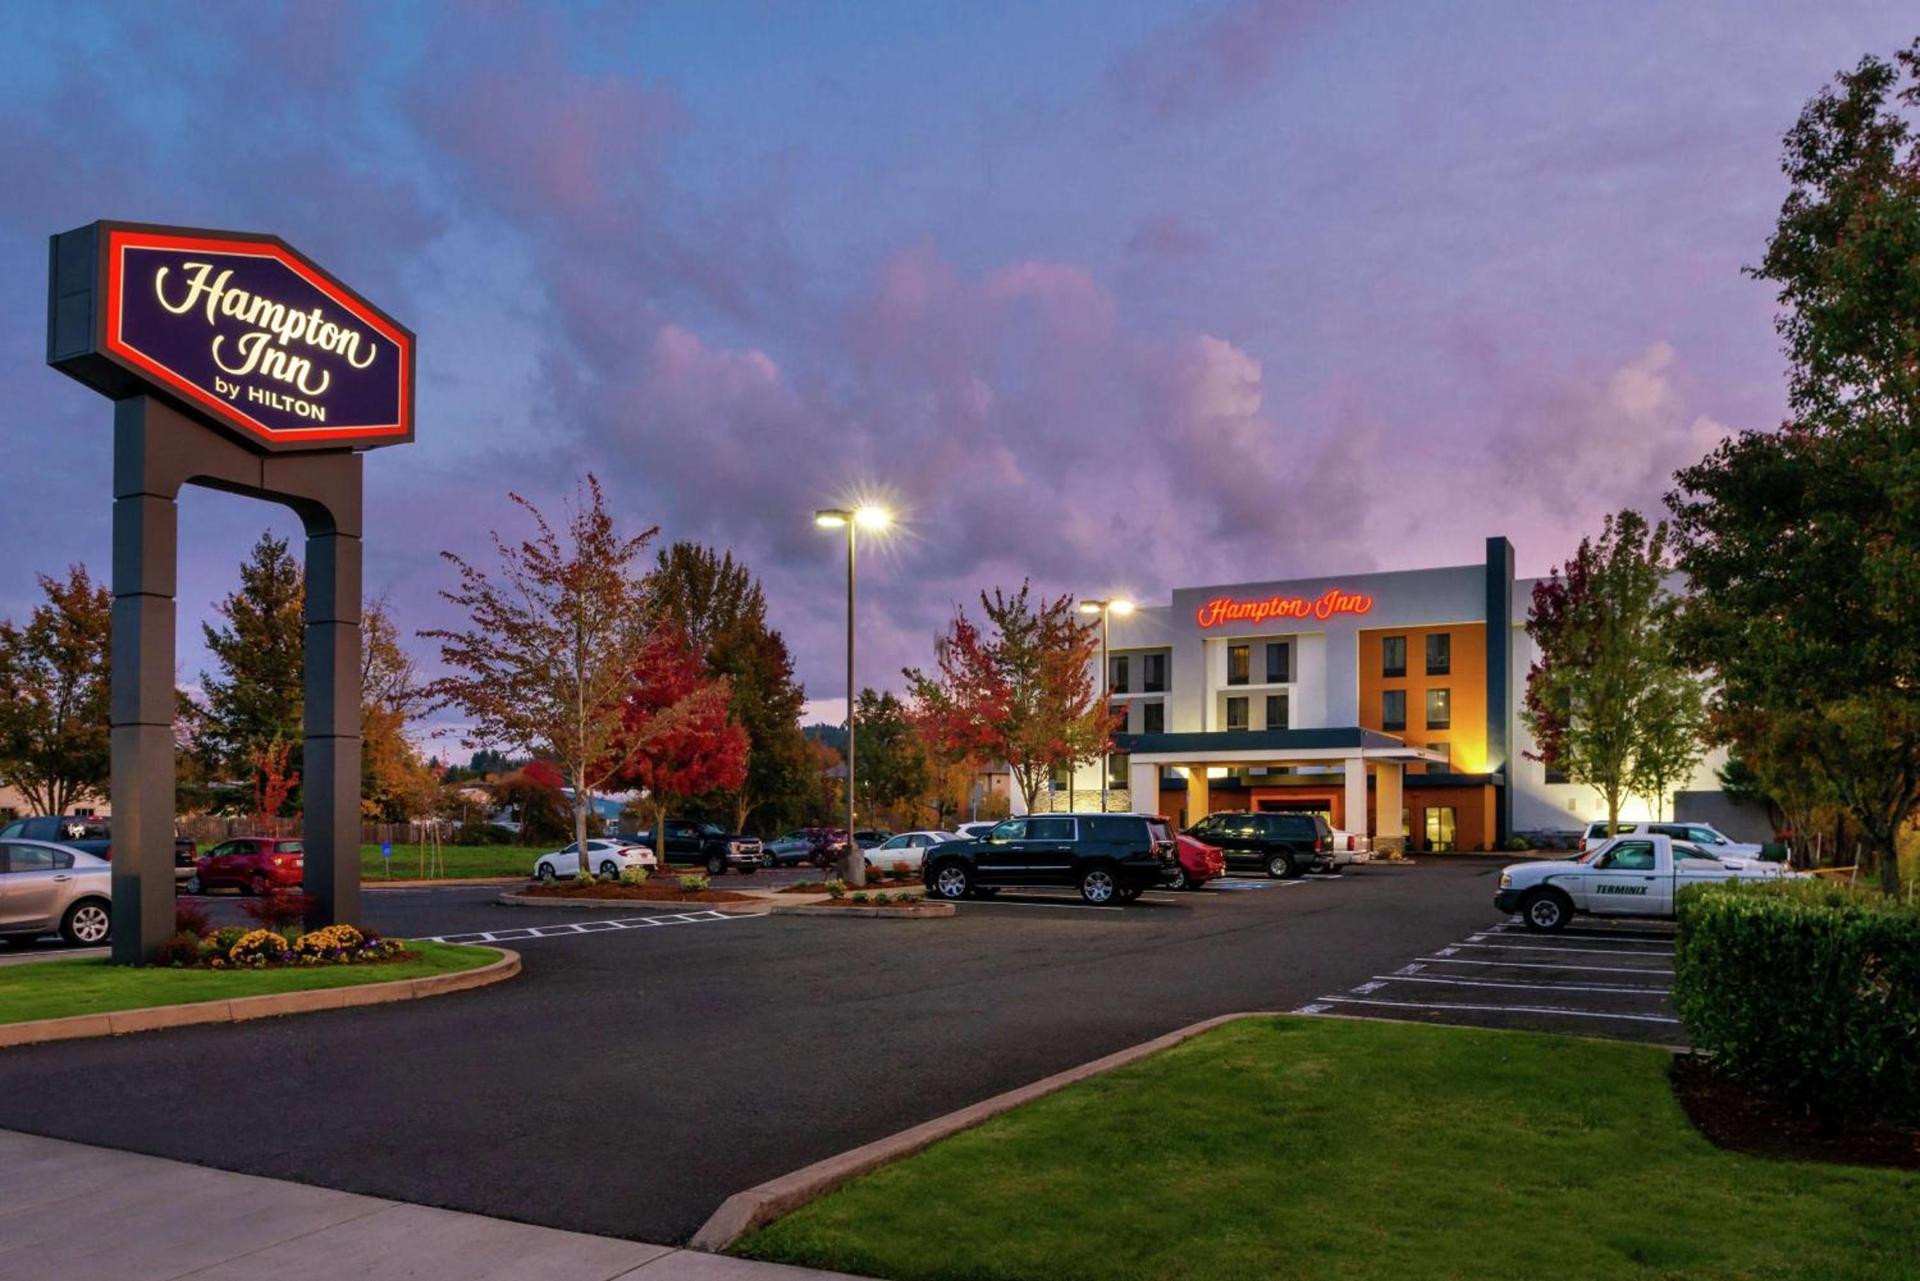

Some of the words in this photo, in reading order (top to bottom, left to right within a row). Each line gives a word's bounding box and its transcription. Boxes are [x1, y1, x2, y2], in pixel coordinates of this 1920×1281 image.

[155, 262, 377, 369] Hampton
[212, 332, 330, 396] Inn
[214, 376, 241, 400] by
[248, 386, 326, 422] HILTON
[1199, 598, 1312, 627] Hampton
[1315, 590, 1372, 619] Inn
[1597, 885, 1648, 896] TERMINIX
